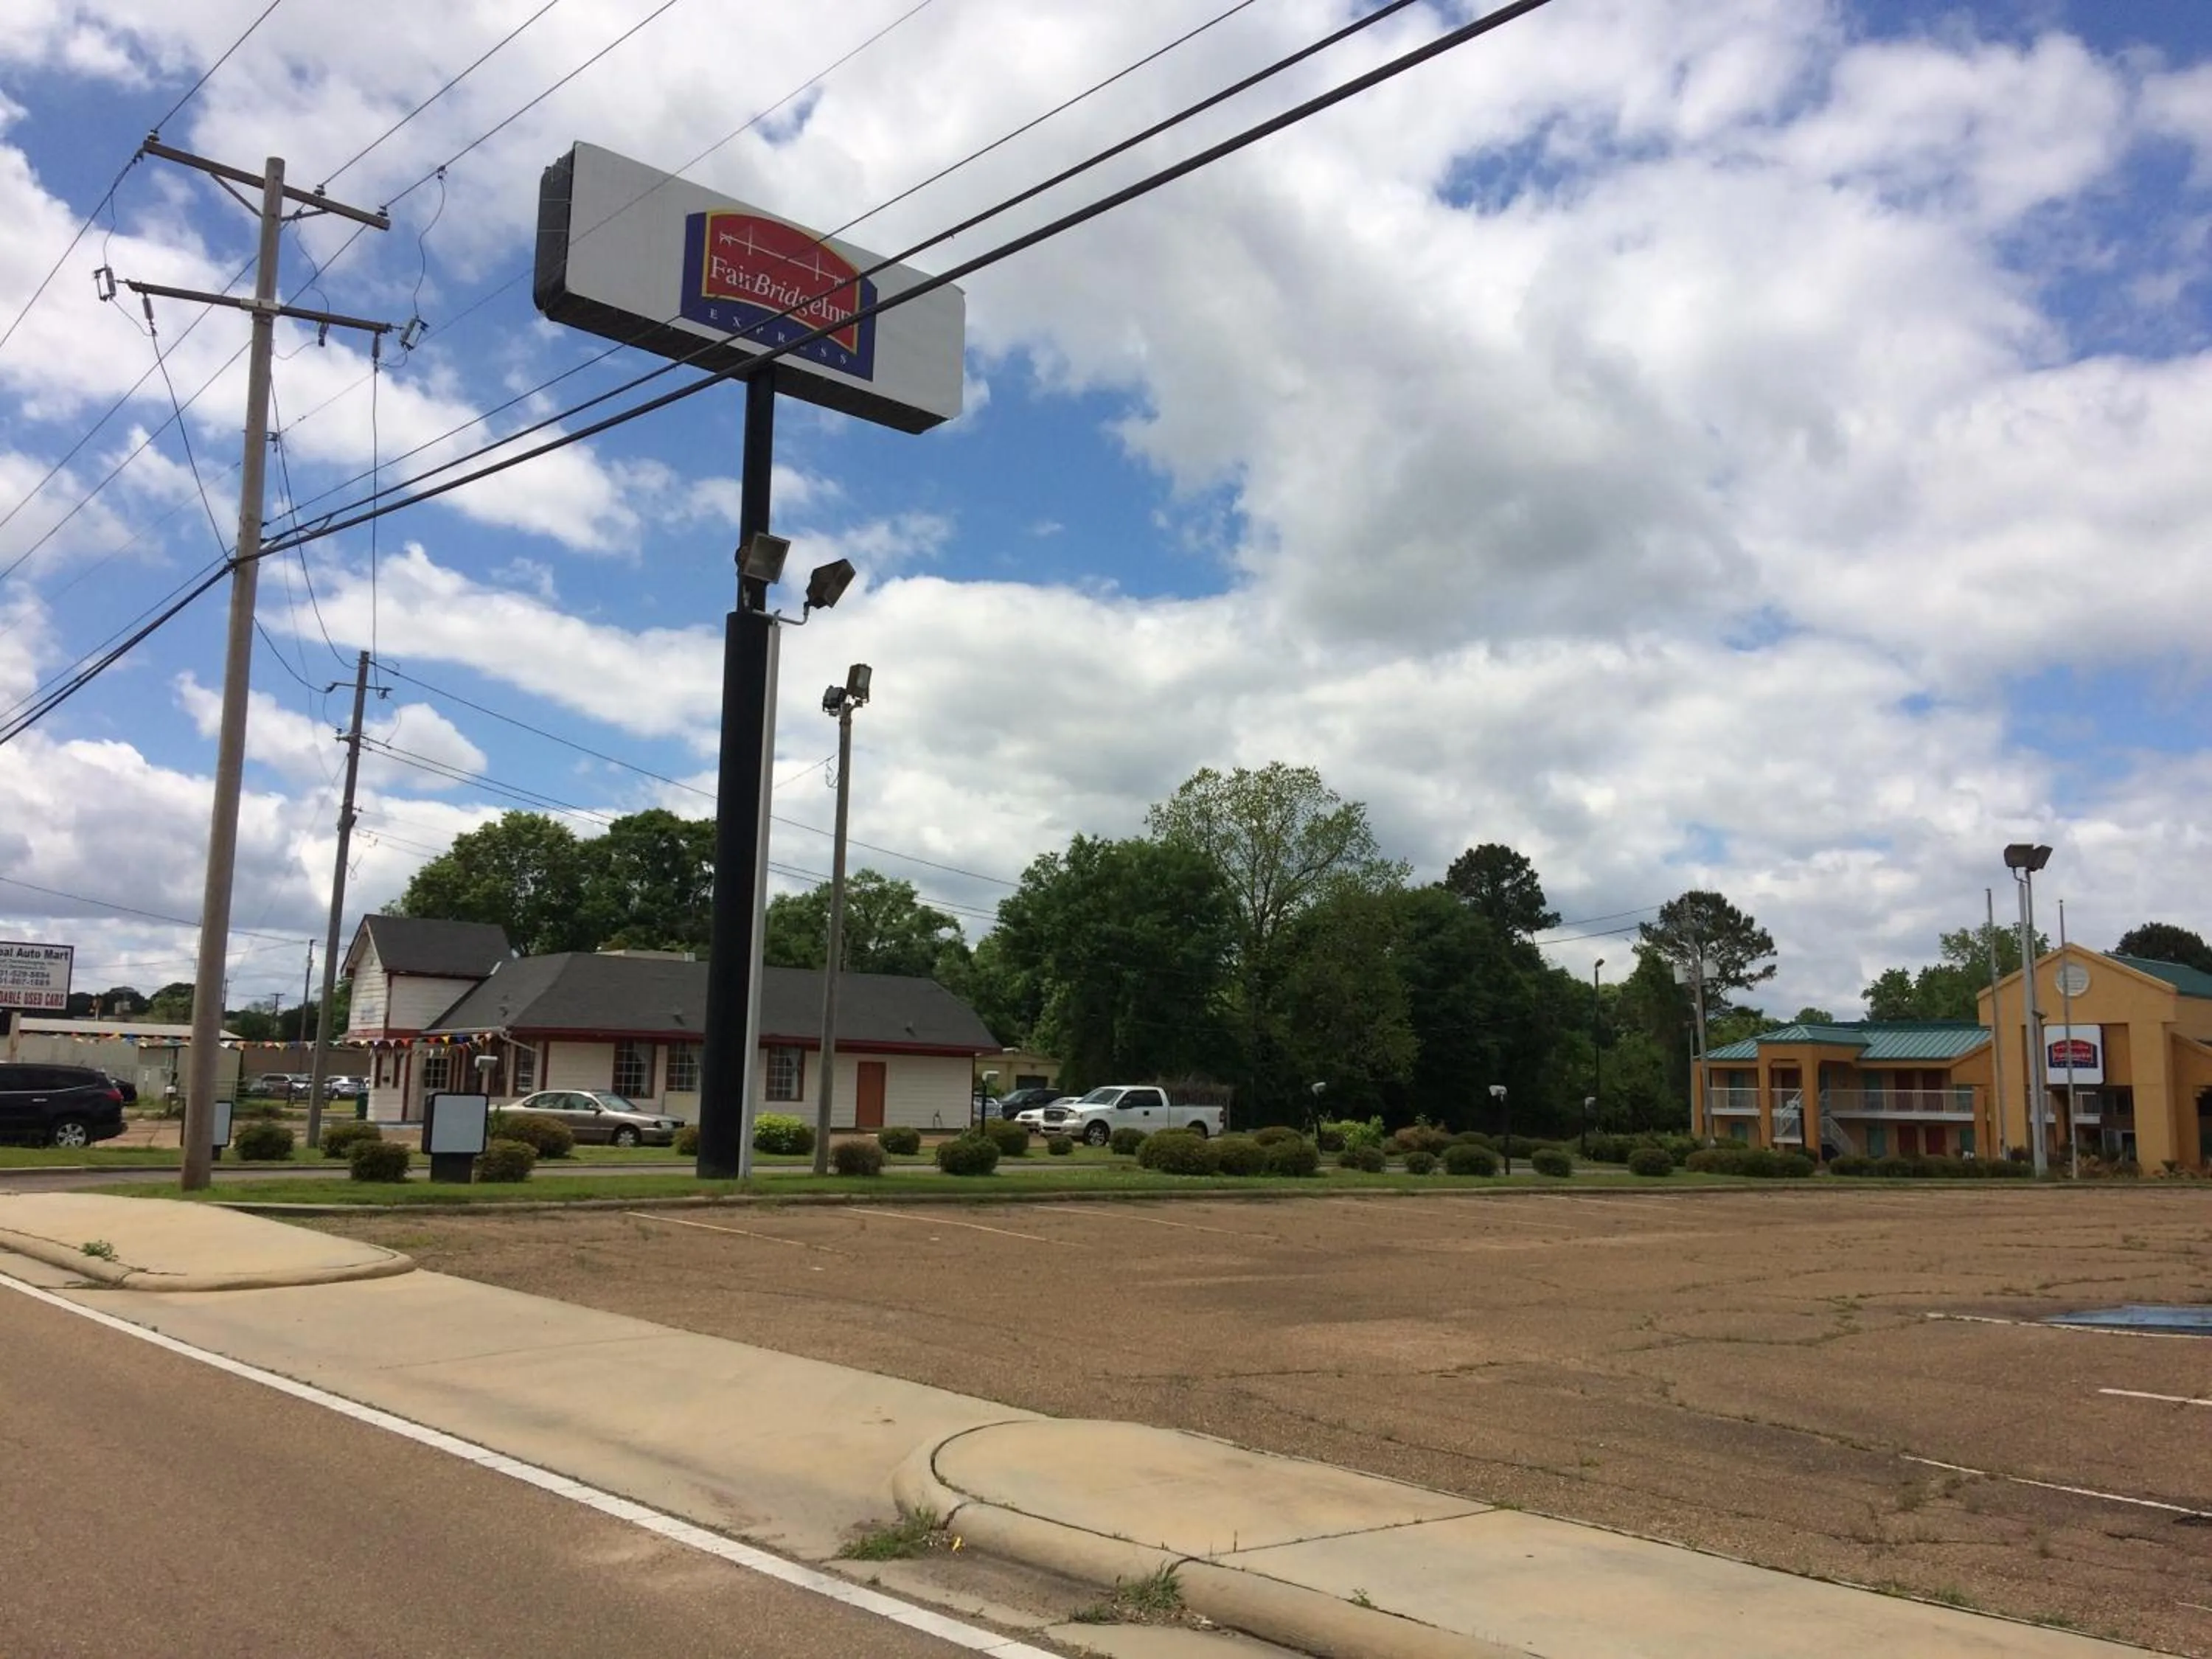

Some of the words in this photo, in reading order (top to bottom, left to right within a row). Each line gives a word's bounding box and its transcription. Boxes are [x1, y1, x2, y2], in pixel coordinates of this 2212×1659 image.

[709, 307, 847, 364] EXRSS
[16, 947, 41, 959] Auto
[44, 949, 69, 961] Mart
[24, 992, 44, 1005] USED
[45, 992, 64, 1006] CARS
